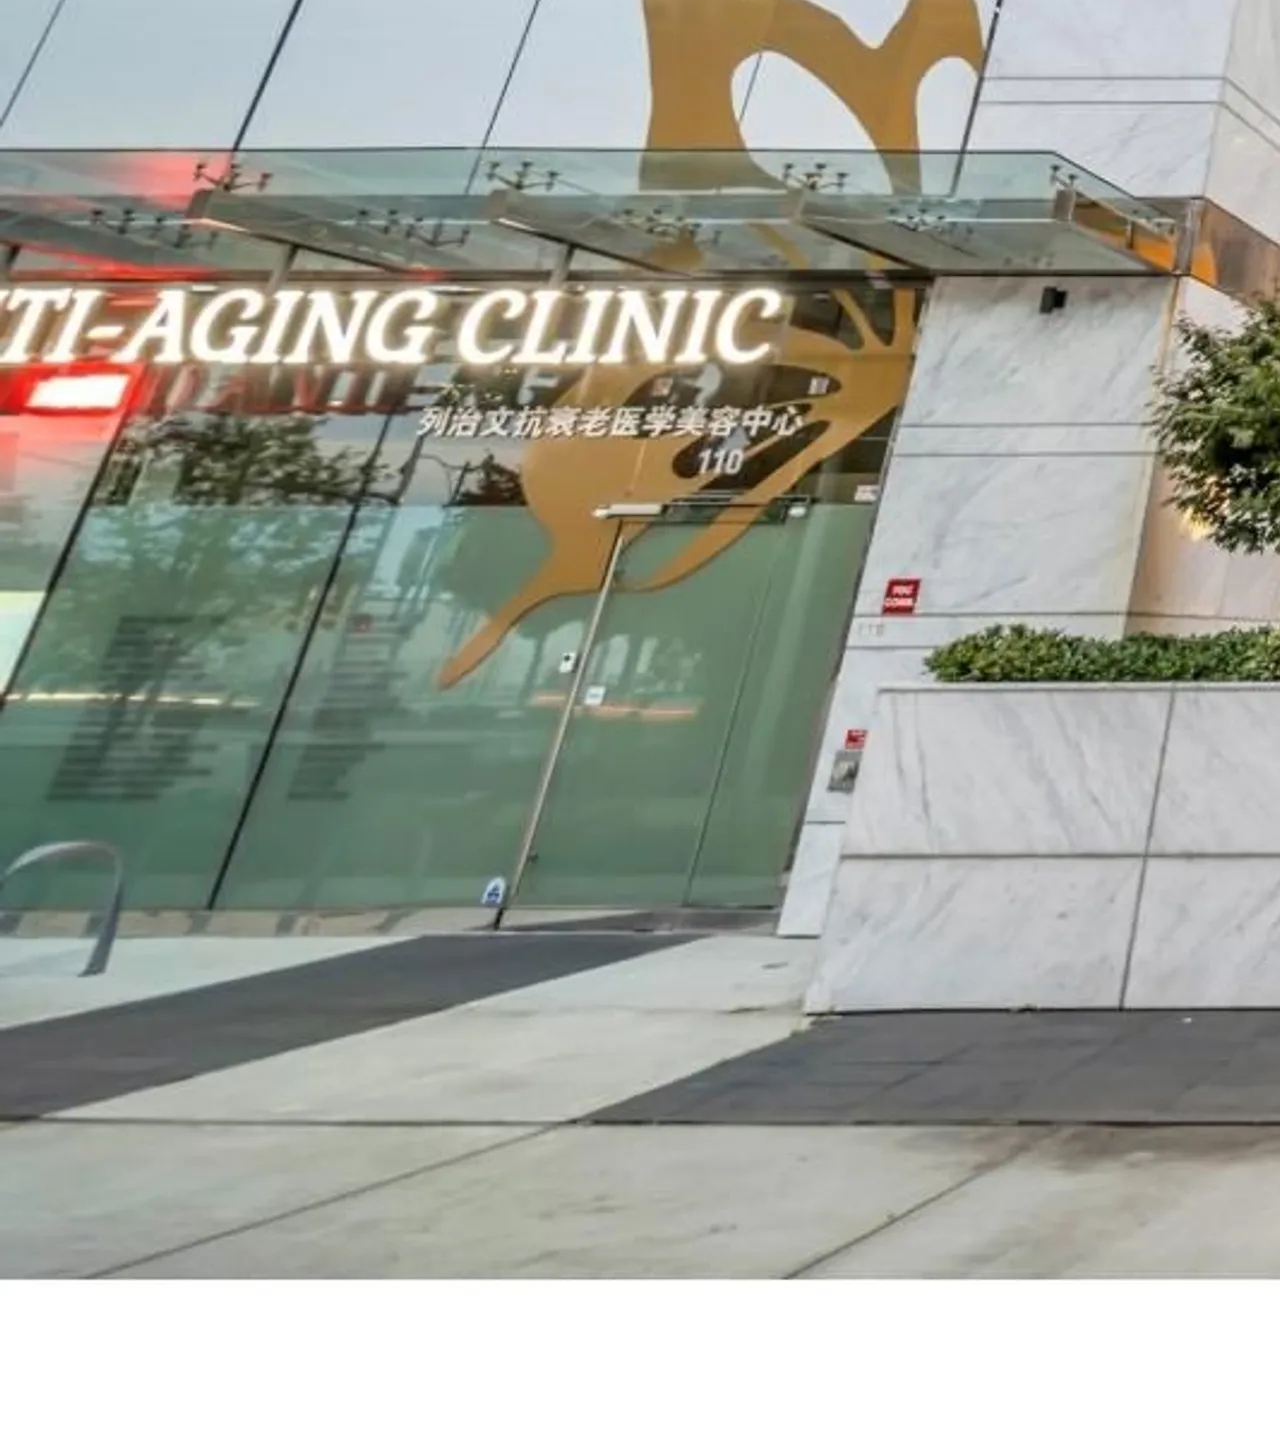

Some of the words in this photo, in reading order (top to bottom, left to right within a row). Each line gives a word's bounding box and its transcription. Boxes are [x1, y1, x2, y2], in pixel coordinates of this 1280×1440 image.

[0, 287, 439, 364] TI-AGING
[457, 287, 782, 364] CLINIC
[417, 404, 804, 437] 列治文抗衰老医学美容中心
[699, 448, 744, 476] 110
